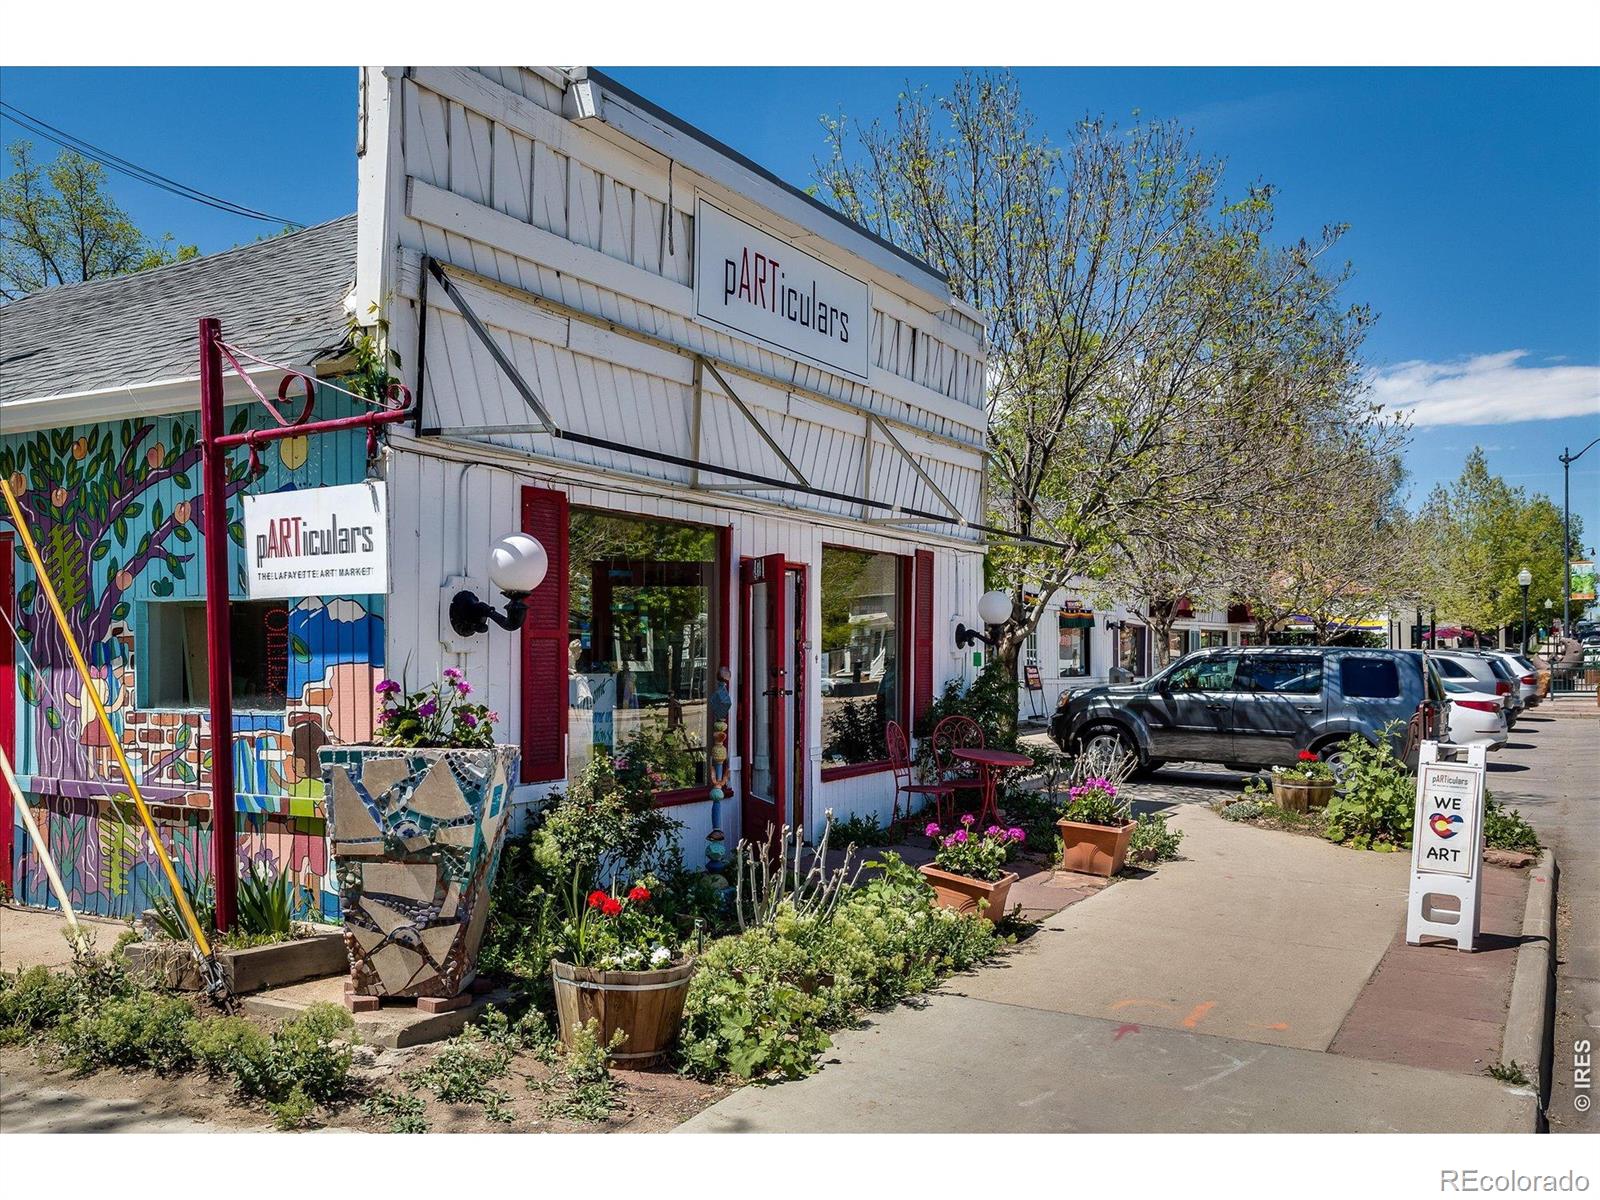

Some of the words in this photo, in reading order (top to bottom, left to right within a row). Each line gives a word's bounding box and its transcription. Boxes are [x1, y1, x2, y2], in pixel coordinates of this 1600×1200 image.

[724, 247, 849, 343] pARTiculars
[256, 513, 374, 568] pARTiculars
[258, 572, 272, 581] THE
[274, 569, 317, 580] LAFAYETTE
[320, 569, 335, 578] ART
[339, 567, 372, 577] MARKET
[1434, 796, 1461, 810] WE
[1426, 846, 1461, 862] ART
